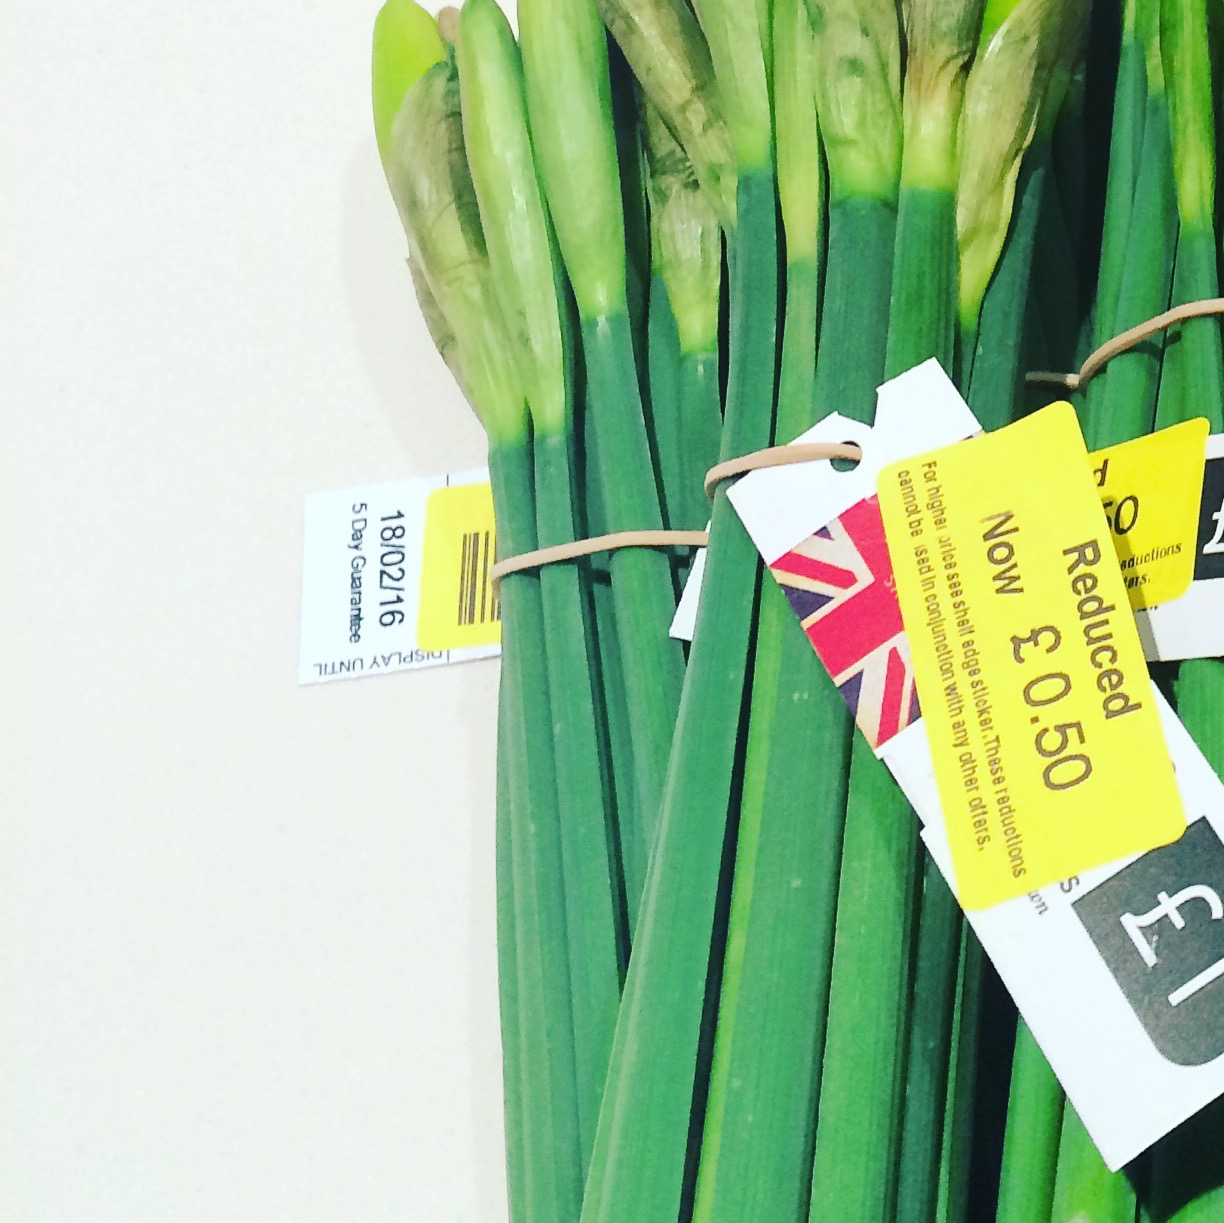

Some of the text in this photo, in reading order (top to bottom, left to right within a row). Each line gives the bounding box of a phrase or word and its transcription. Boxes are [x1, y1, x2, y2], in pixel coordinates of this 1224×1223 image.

[922, 460, 937, 483] For
[898, 470, 922, 518] cannot
[927, 485, 947, 531] higher
[908, 518, 923, 537] be
[347, 502, 367, 644] 5 Day Guarantee
[379, 510, 405, 627] 18/02/16
[1120, 542, 1182, 571] eductions
[921, 575, 937, 592] in
[947, 572, 963, 598] see
[925, 594, 955, 682] conjunction
[953, 600, 975, 637] shelf
[1062, 538, 1143, 720] Reduced
[313, 657, 364, 676] UNTIL
[961, 639, 981, 677] edge
[980, 510, 1093, 791] Now £ 0.50
[944, 681, 965, 719] with
[952, 719, 969, 748] any
[959, 751, 980, 793] other
[968, 796, 991, 852] offers.
[994, 787, 1027, 878] reductions
